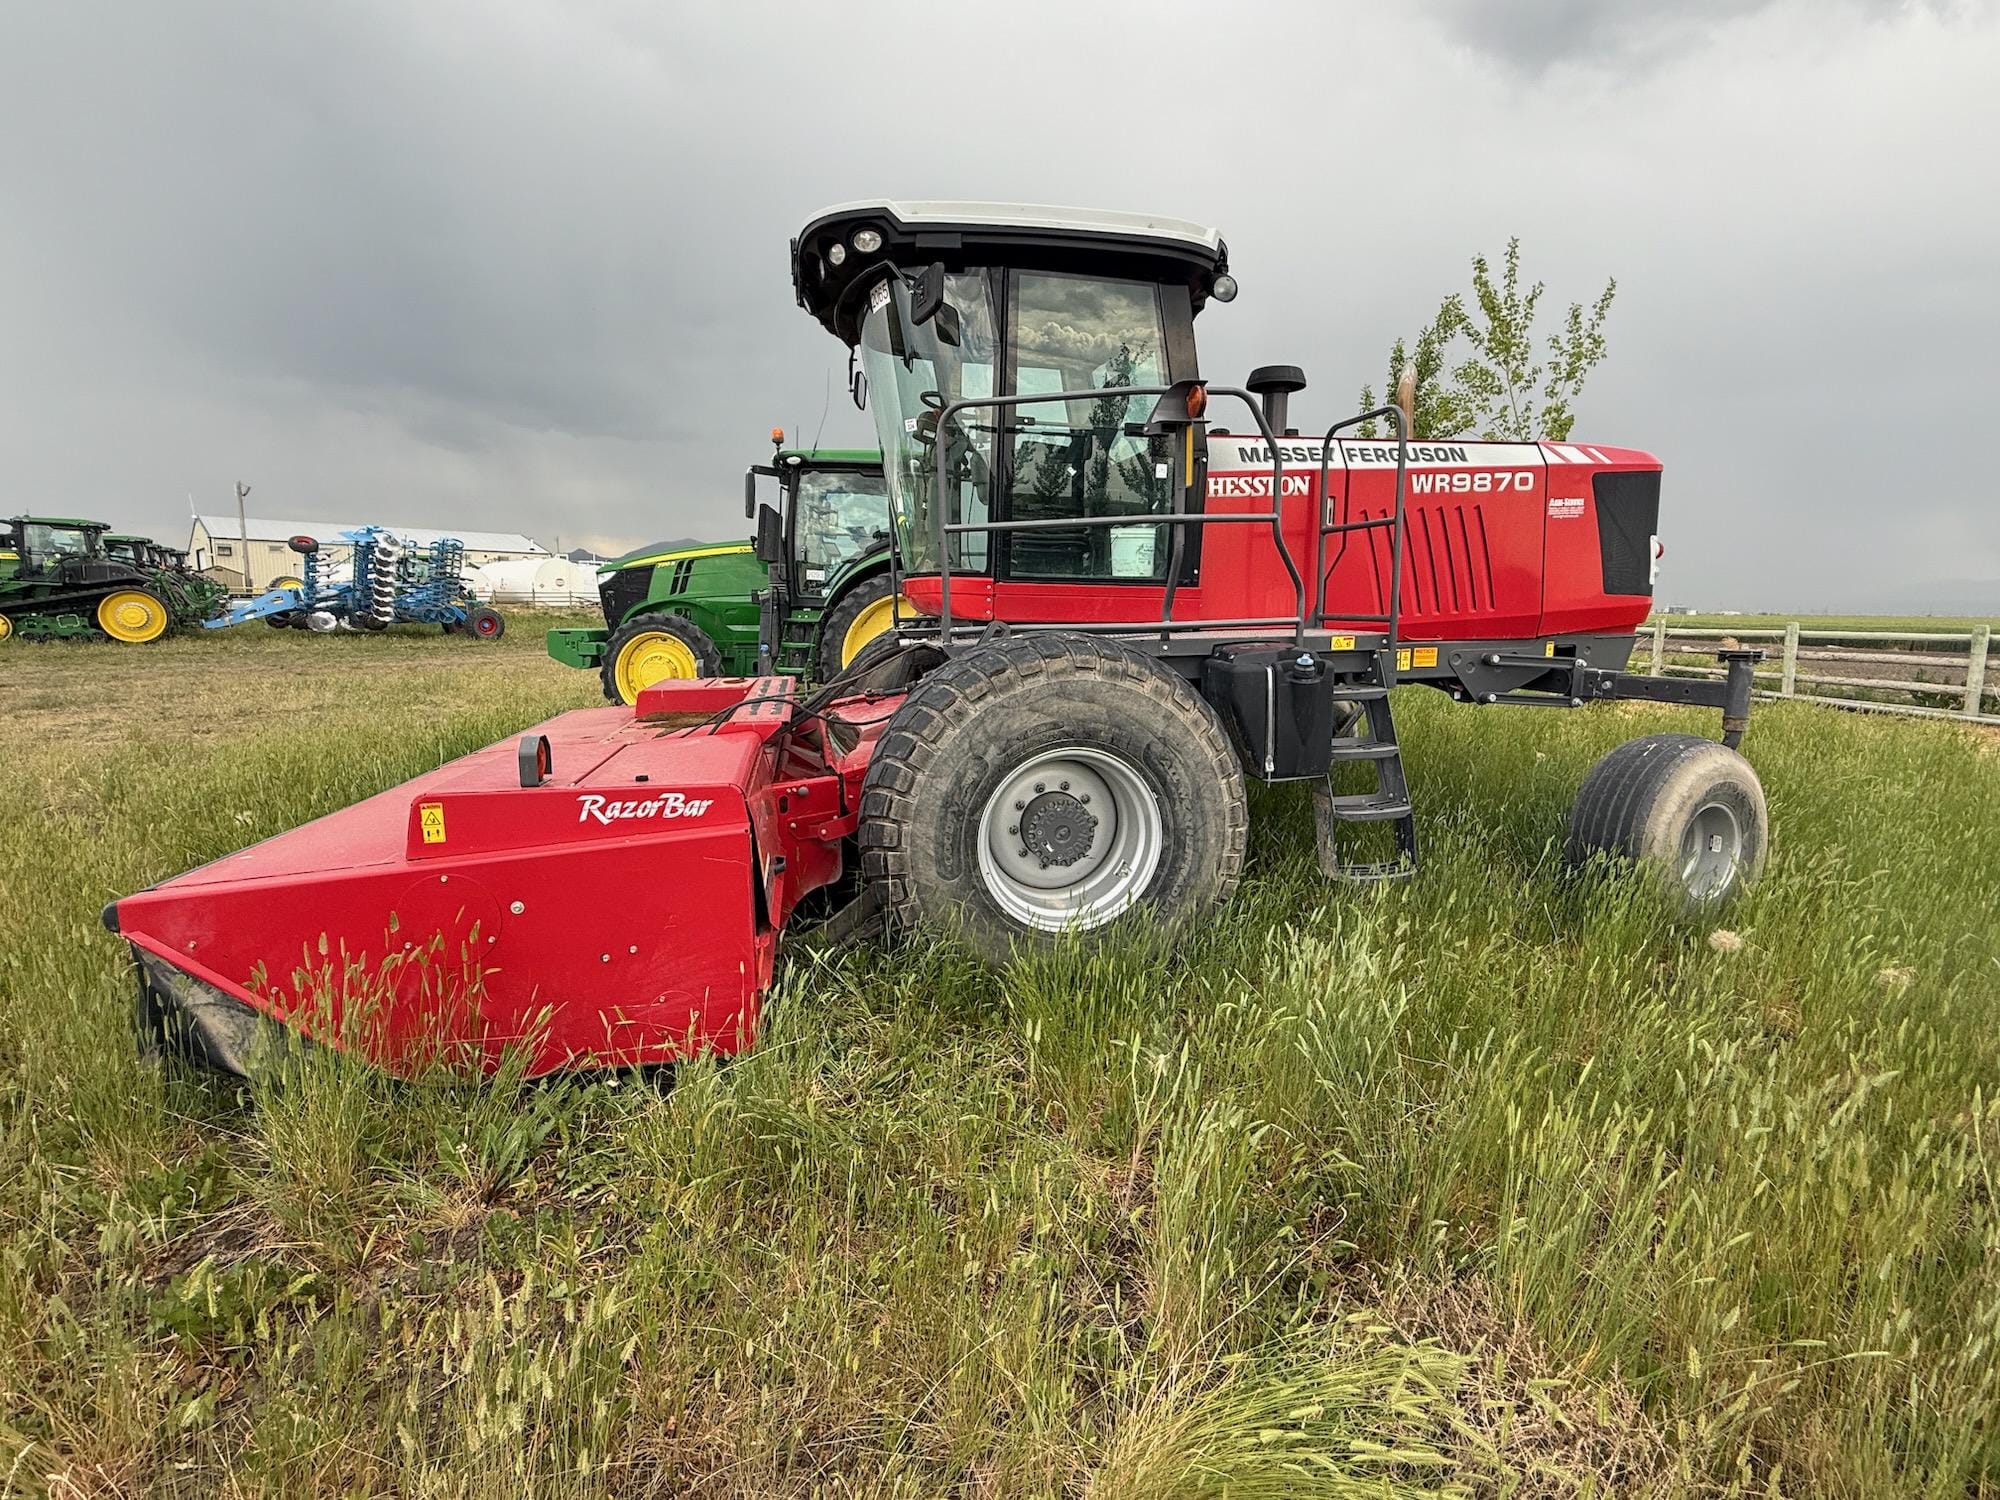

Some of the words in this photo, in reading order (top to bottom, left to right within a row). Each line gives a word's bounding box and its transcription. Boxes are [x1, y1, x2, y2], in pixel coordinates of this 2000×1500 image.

[1238, 446, 1335, 463] MASSEY
[1346, 447, 1468, 462] FERGUSON
[1207, 475, 1311, 497] HESSTON
[1411, 472, 1535, 493] WR9870
[576, 792, 714, 825] RazorBar
